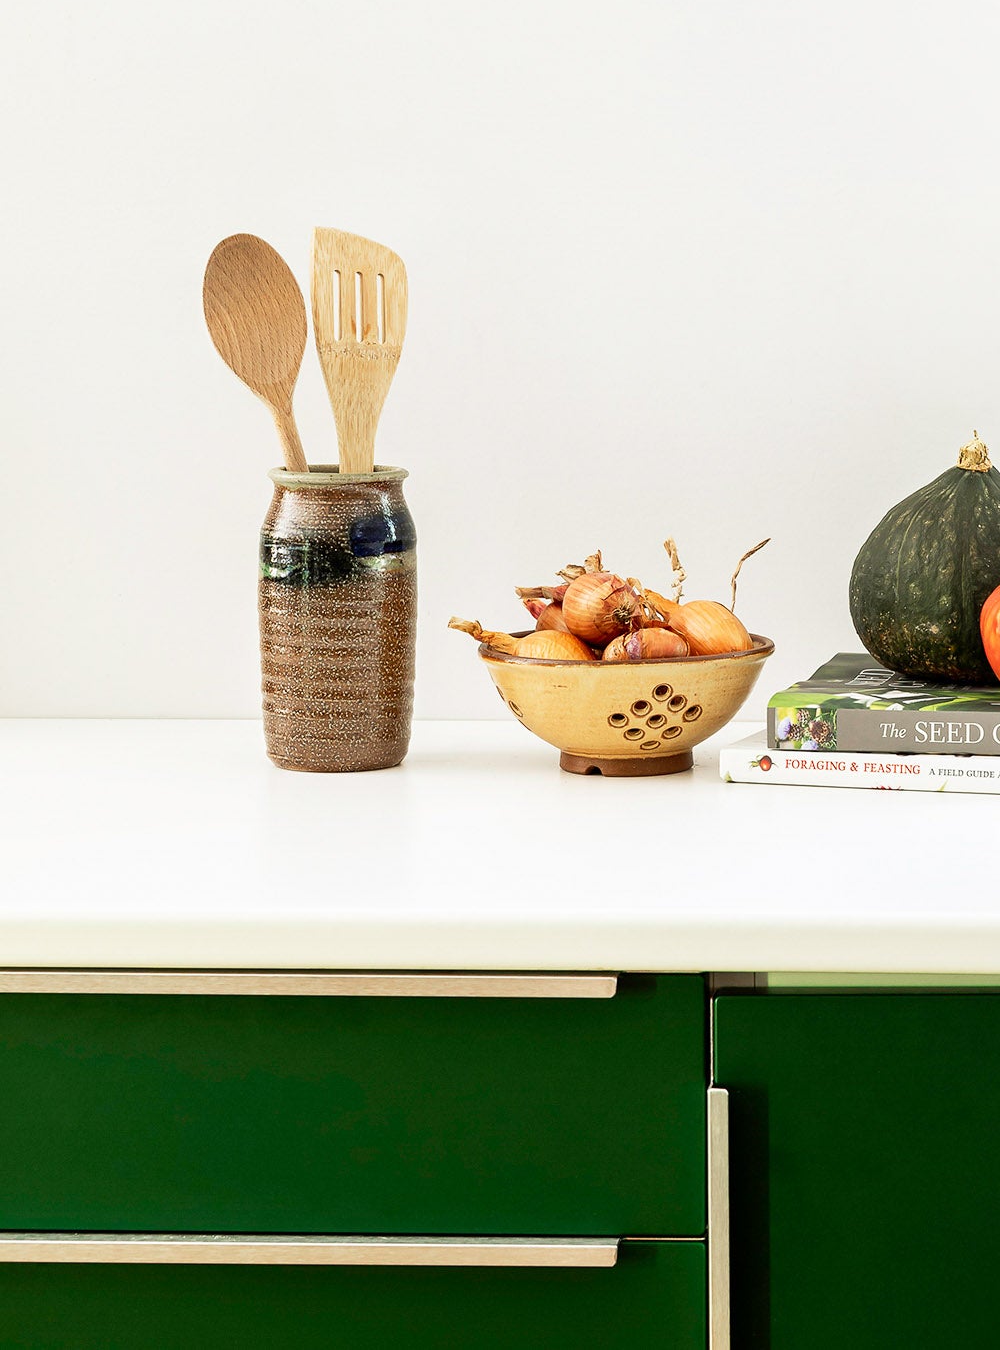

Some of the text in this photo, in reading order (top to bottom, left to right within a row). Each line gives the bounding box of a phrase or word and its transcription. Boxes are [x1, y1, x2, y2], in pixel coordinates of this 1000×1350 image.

[880, 723, 907, 739] The
[914, 721, 985, 744] SEED
[785, 759, 846, 772] FORAGING
[850, 762, 859, 772] &
[864, 763, 921, 775] FEASTING
[929, 767, 936, 776] A
[938, 768, 964, 778] FIELD
[966, 770, 995, 779] GUIDE
